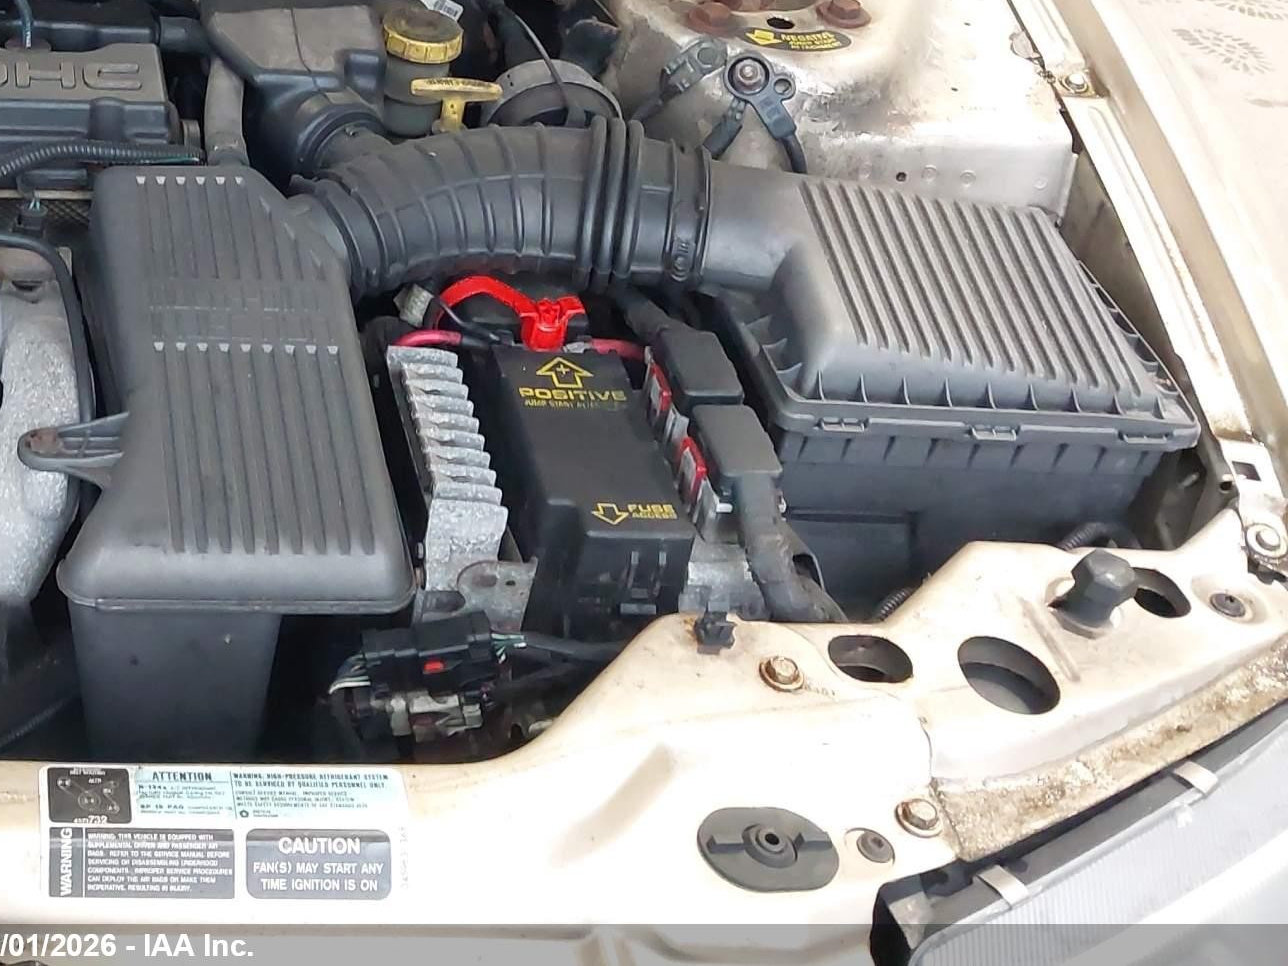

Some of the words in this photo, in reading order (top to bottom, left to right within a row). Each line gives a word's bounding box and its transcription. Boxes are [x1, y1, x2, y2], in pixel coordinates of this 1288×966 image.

[519, 387, 627, 401] POSITIVE
[627, 504, 675, 514] FUSE
[152, 771, 212, 781] ATTENTION
[278, 837, 361, 854] CAUTION
[60, 828, 73, 896] WARNING
[253, 862, 292, 875] FAN(S)
[296, 862, 318, 875] MAY
[323, 862, 357, 875] START
[361, 862, 384, 875] ANY
[261, 879, 287, 891] TIME
[292, 879, 340, 891] IGNITION
[345, 879, 356, 891] IS
[360, 879, 378, 891] ON
